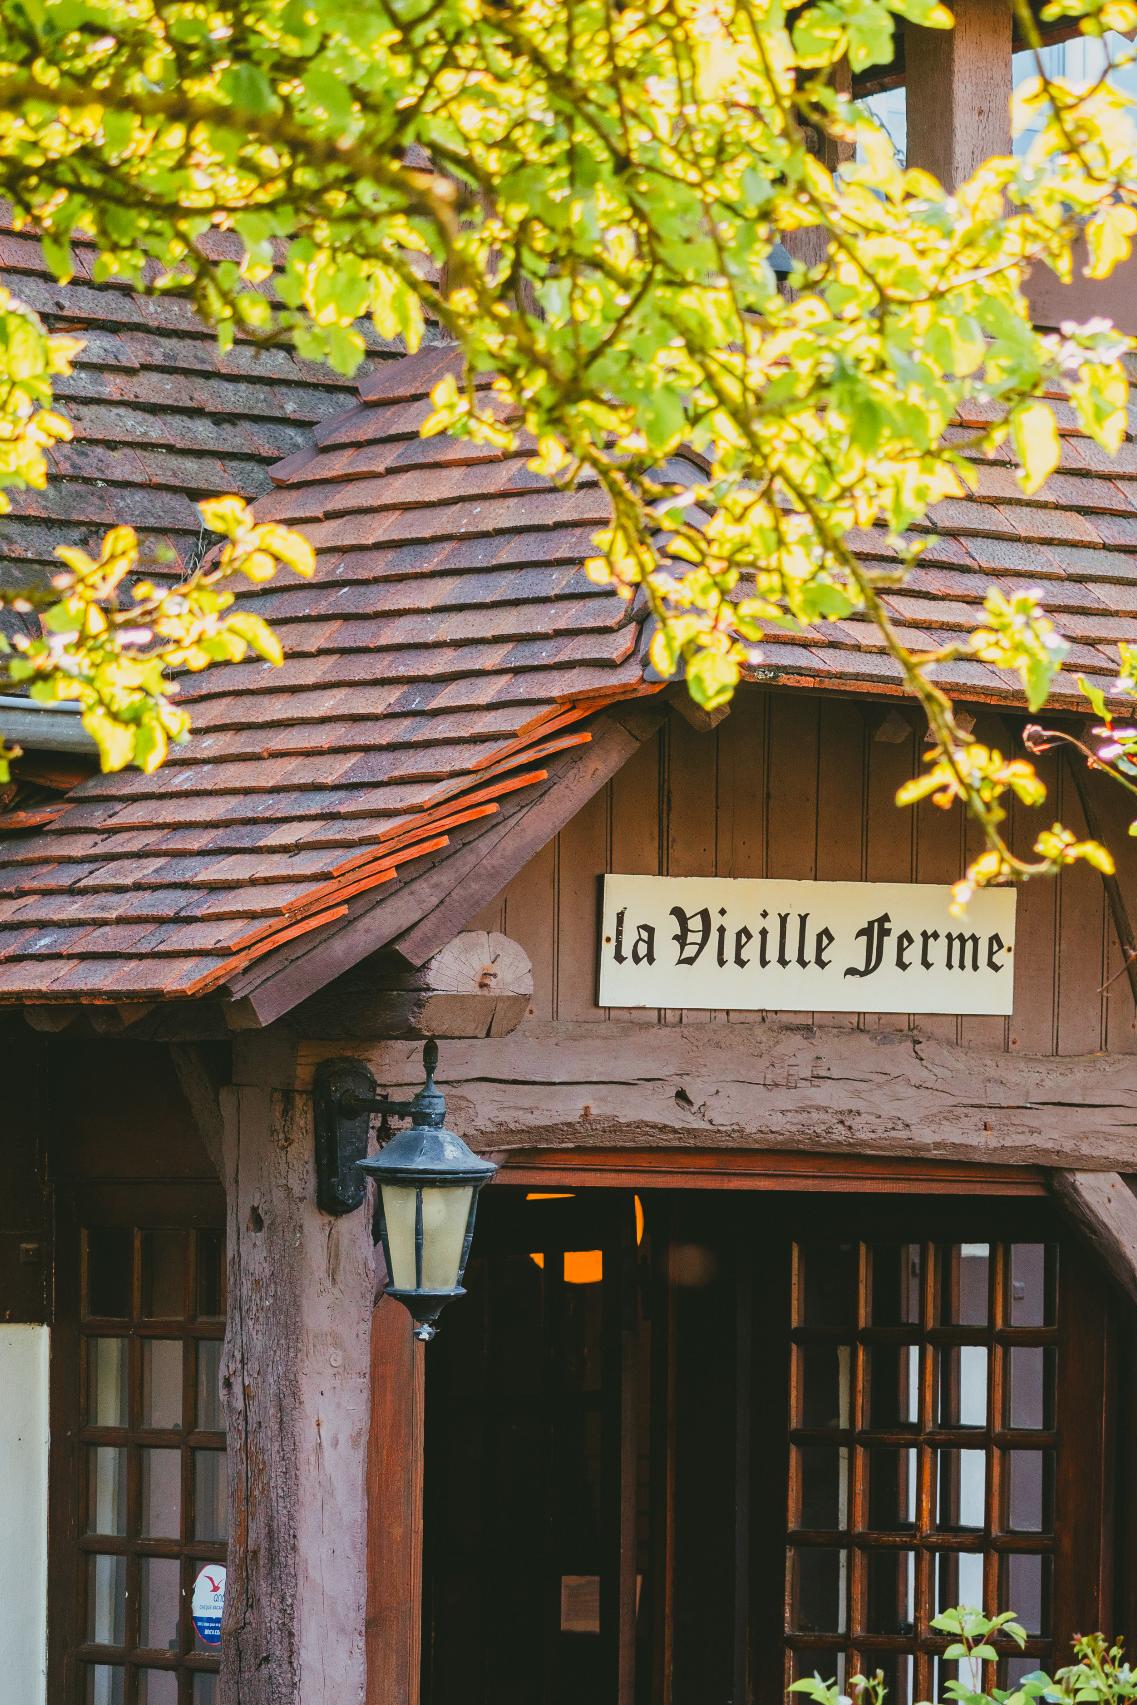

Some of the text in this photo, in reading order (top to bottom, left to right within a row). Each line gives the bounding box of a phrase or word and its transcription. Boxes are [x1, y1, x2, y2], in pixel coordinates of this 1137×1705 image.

[613, 906, 1005, 979] la Vieille Ferme
